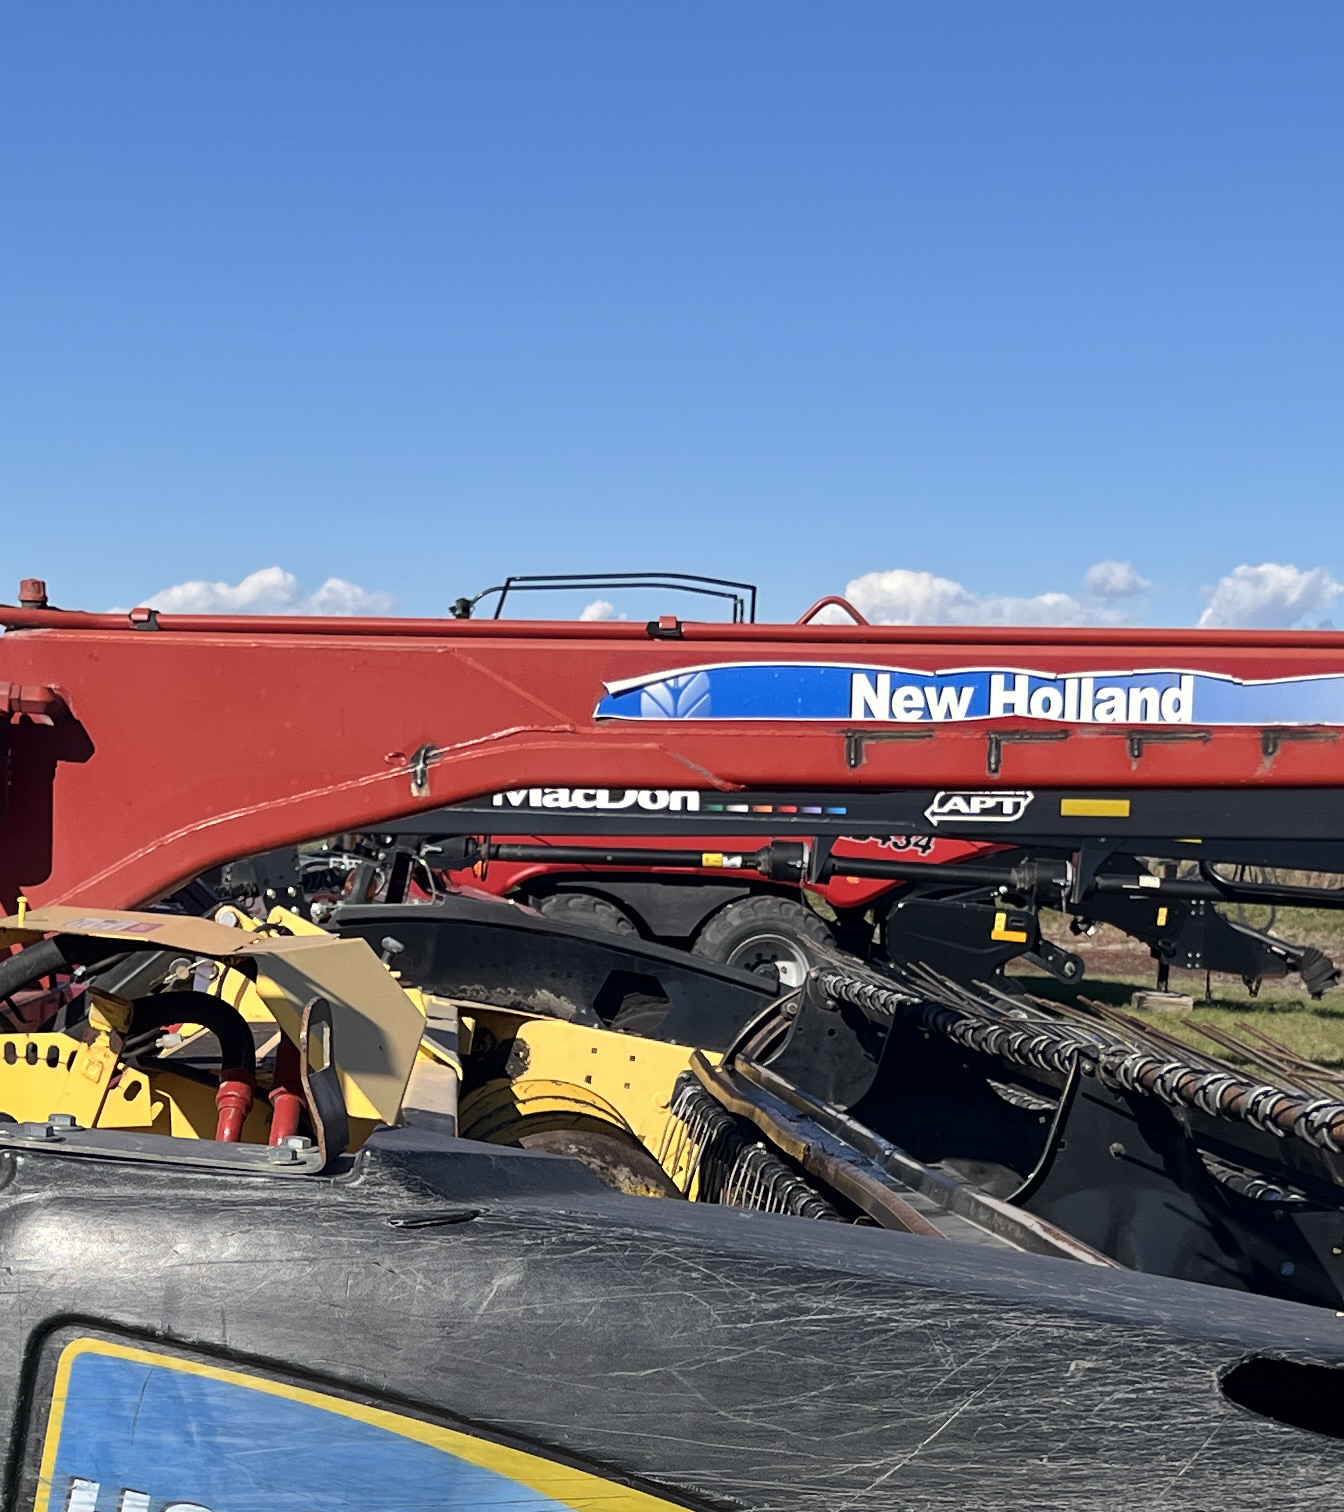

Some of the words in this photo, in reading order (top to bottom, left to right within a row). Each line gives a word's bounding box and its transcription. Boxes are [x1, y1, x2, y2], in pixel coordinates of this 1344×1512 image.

[851, 673, 975, 721] New
[989, 674, 1194, 722] Holland
[492, 788, 700, 811] MacDon
[940, 796, 1026, 814] APT
